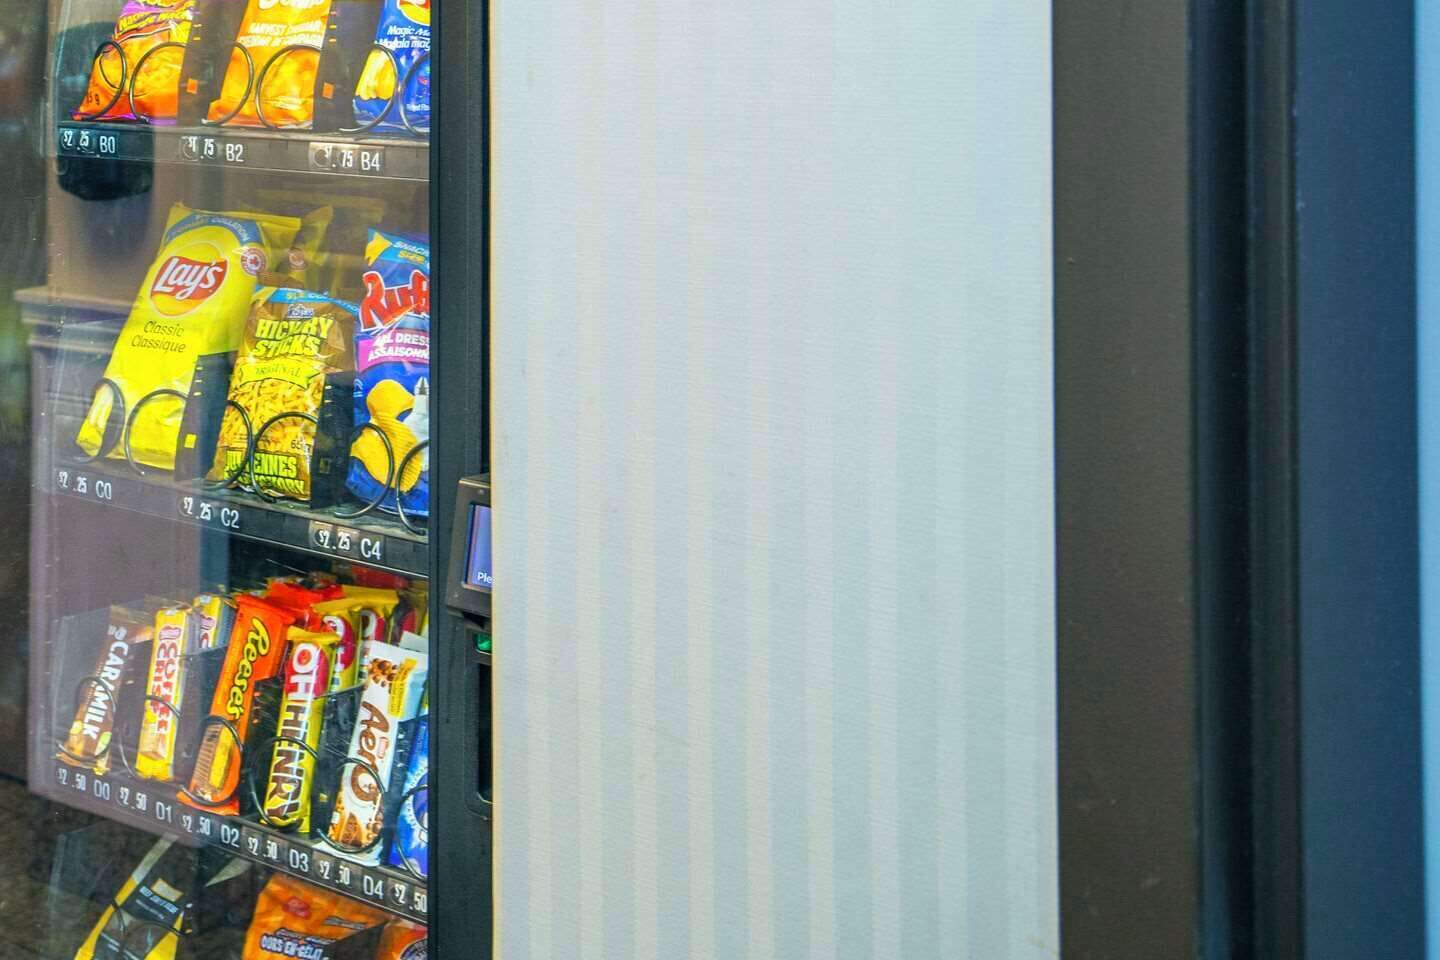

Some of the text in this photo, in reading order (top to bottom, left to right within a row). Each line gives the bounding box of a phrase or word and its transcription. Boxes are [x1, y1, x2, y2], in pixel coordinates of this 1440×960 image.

[99, 136, 116, 153] B0
[226, 144, 244, 162] B2
[361, 152, 380, 171] B4
[153, 257, 224, 300] Lay's
[143, 320, 185, 338] Classic
[131, 334, 186, 354] Classique
[95, 480, 112, 499] C0
[221, 508, 240, 529] C2
[361, 538, 381, 560] C4
[226, 617, 270, 721] Reese's
[288, 642, 321, 702] OH
[363, 876, 384, 900] D4
